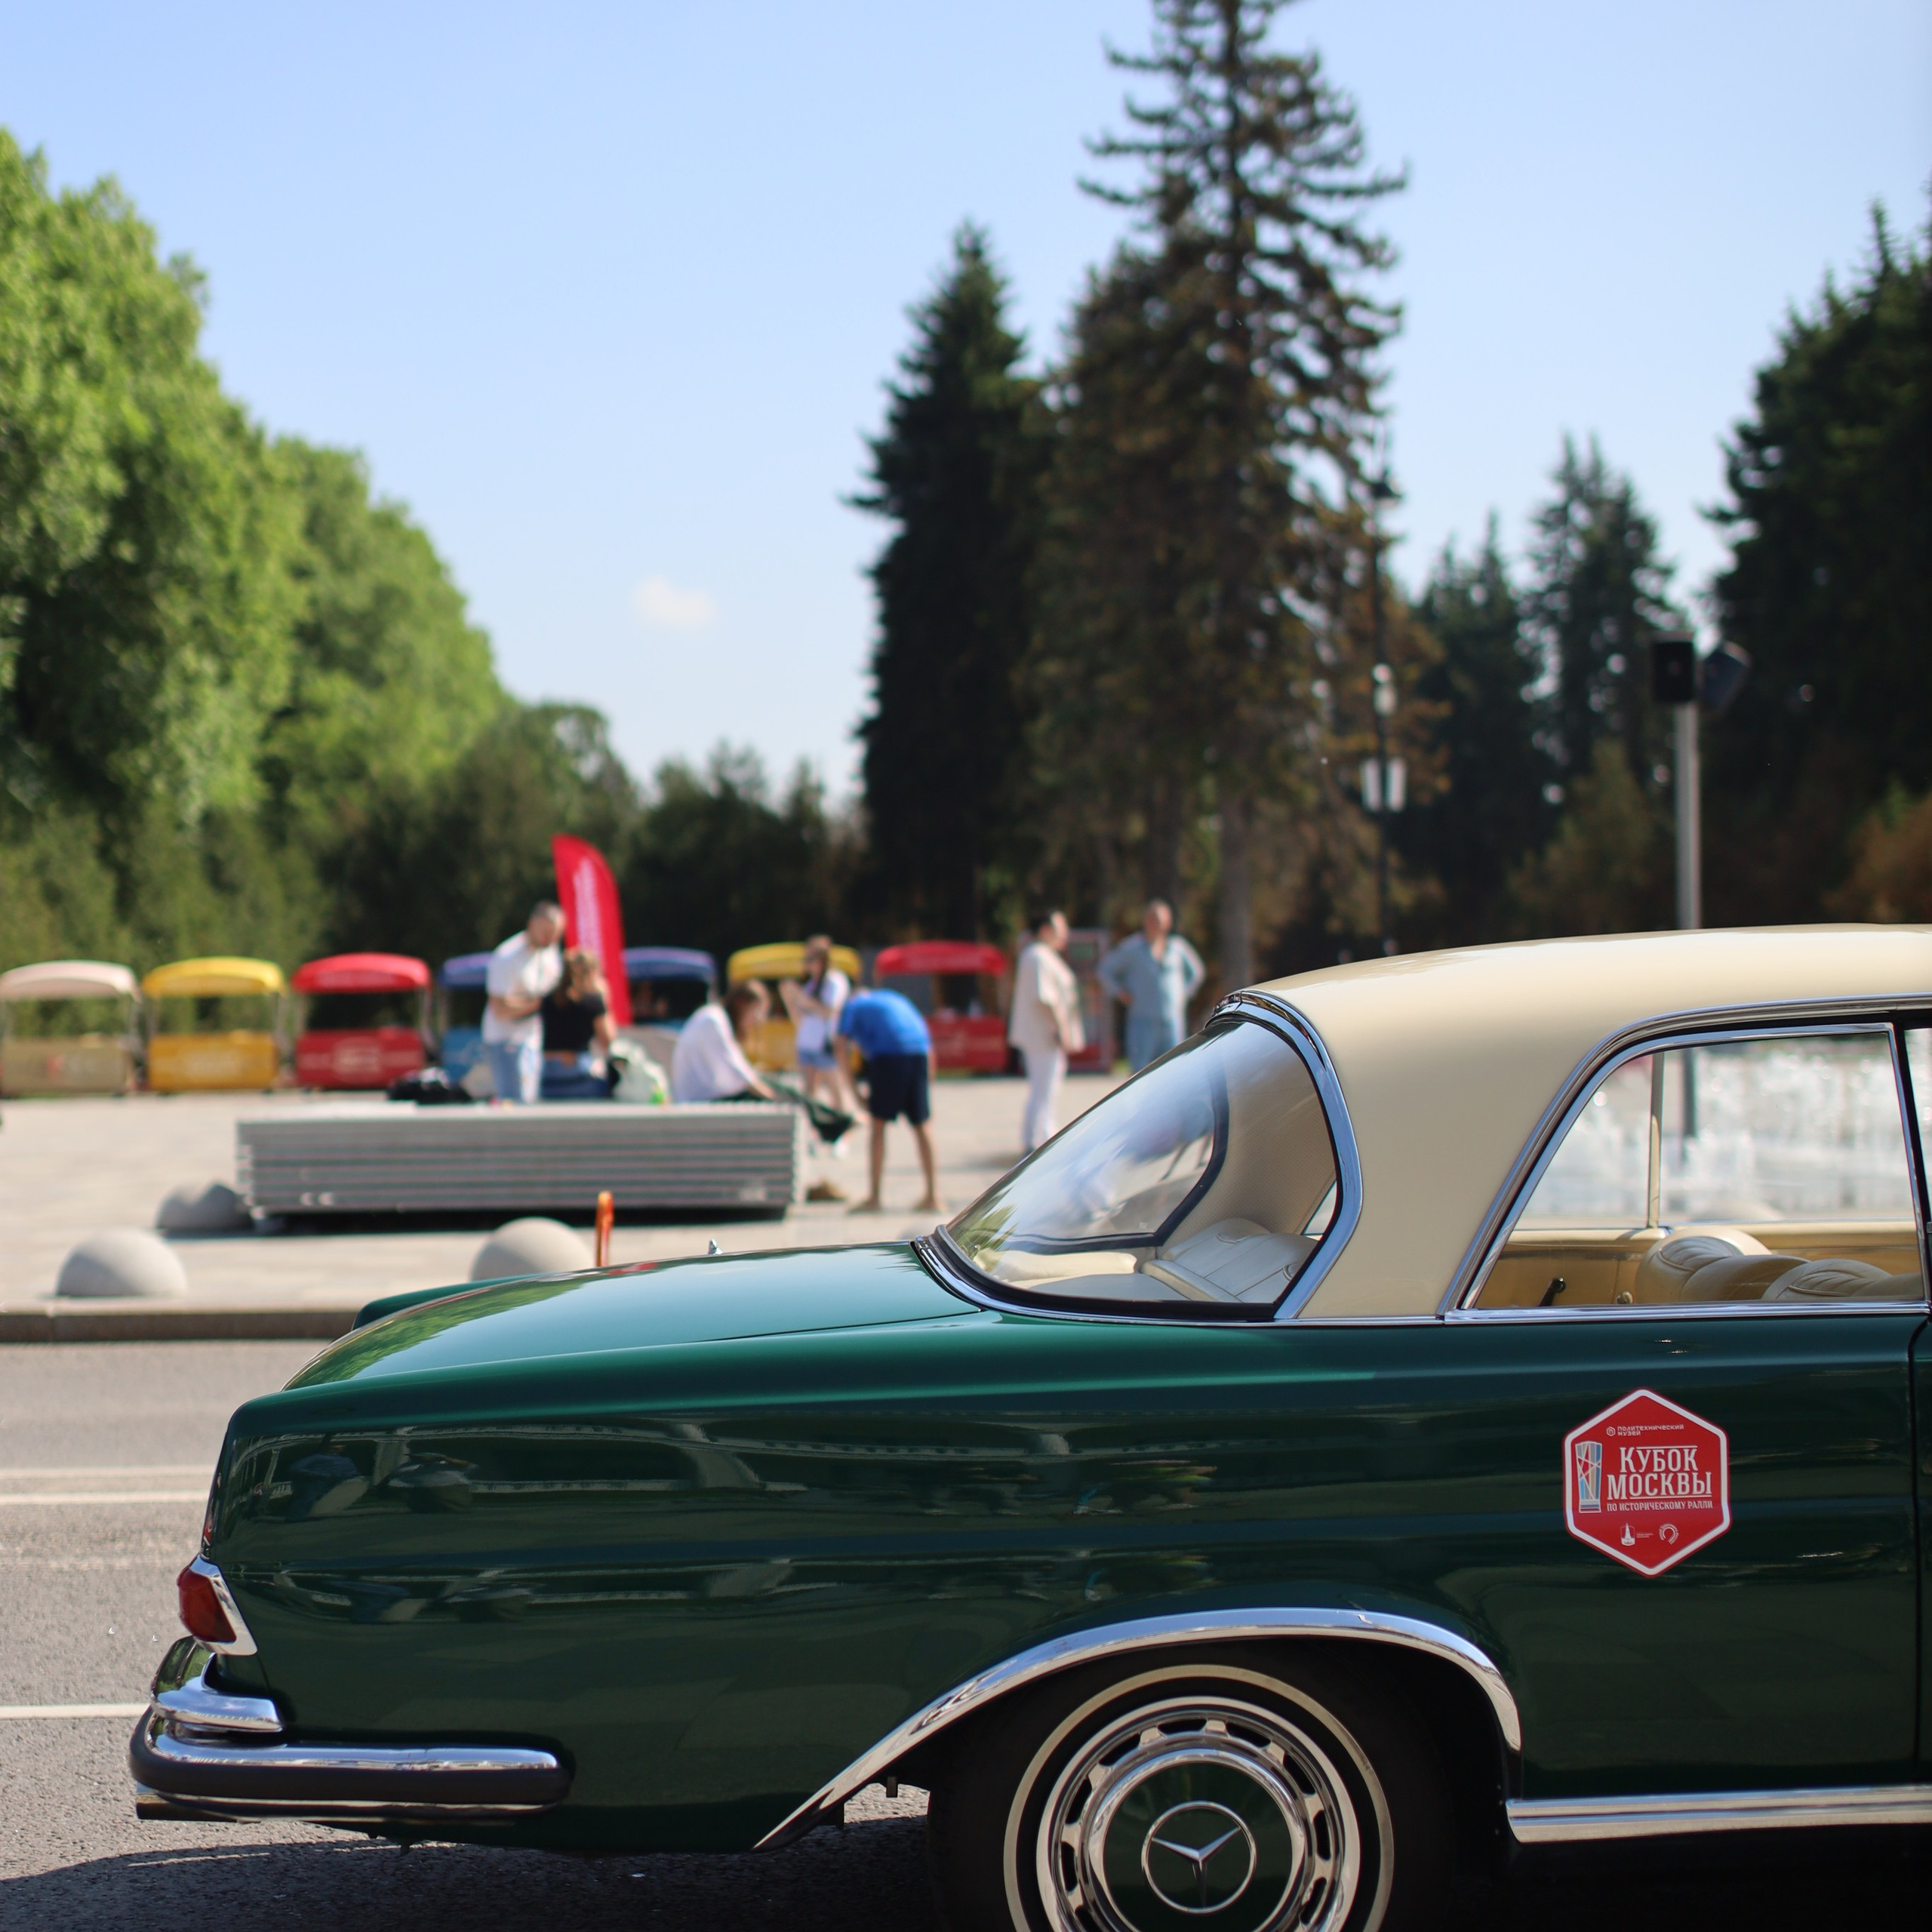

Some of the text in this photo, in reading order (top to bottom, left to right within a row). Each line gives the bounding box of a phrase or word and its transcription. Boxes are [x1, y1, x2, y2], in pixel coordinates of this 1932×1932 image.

[1620, 1447, 1698, 1473] КУБОК
[1607, 1472, 1712, 1500] МОСКВЫ
[1607, 1500, 1713, 1512] ПО ИСТОРИЧЕСКОМУ РАЛЛИ
